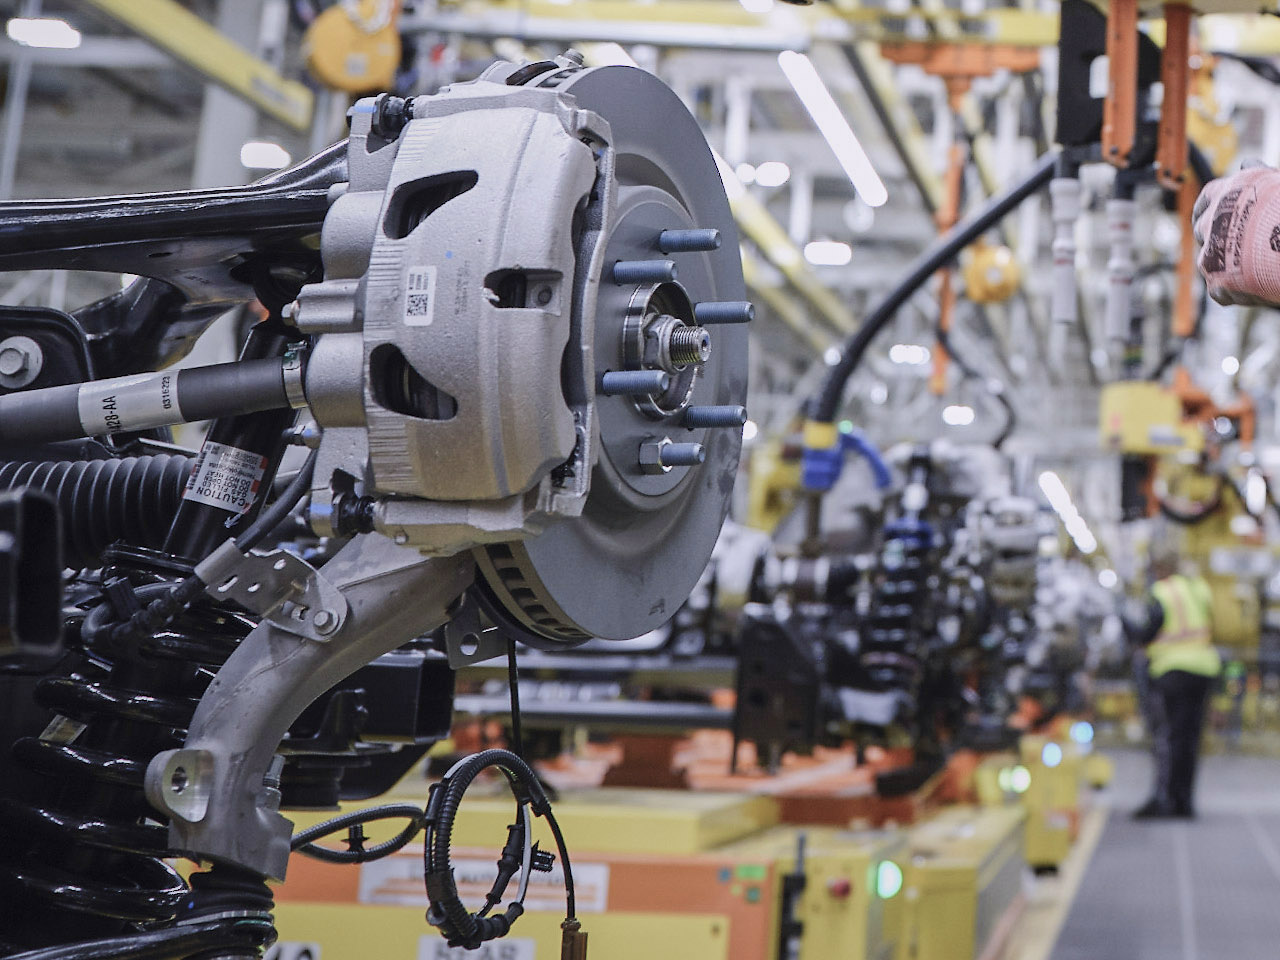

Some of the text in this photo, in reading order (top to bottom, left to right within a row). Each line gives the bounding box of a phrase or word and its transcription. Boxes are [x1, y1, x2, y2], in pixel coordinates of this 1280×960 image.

[206, 470, 223, 479] HEAT
[204, 476, 222, 484] OPEN
[225, 475, 240, 483] NOT
[241, 479, 251, 487] DO
[202, 481, 229, 493] FILLED
[239, 485, 250, 493] DO
[196, 487, 246, 507] CAUTION
